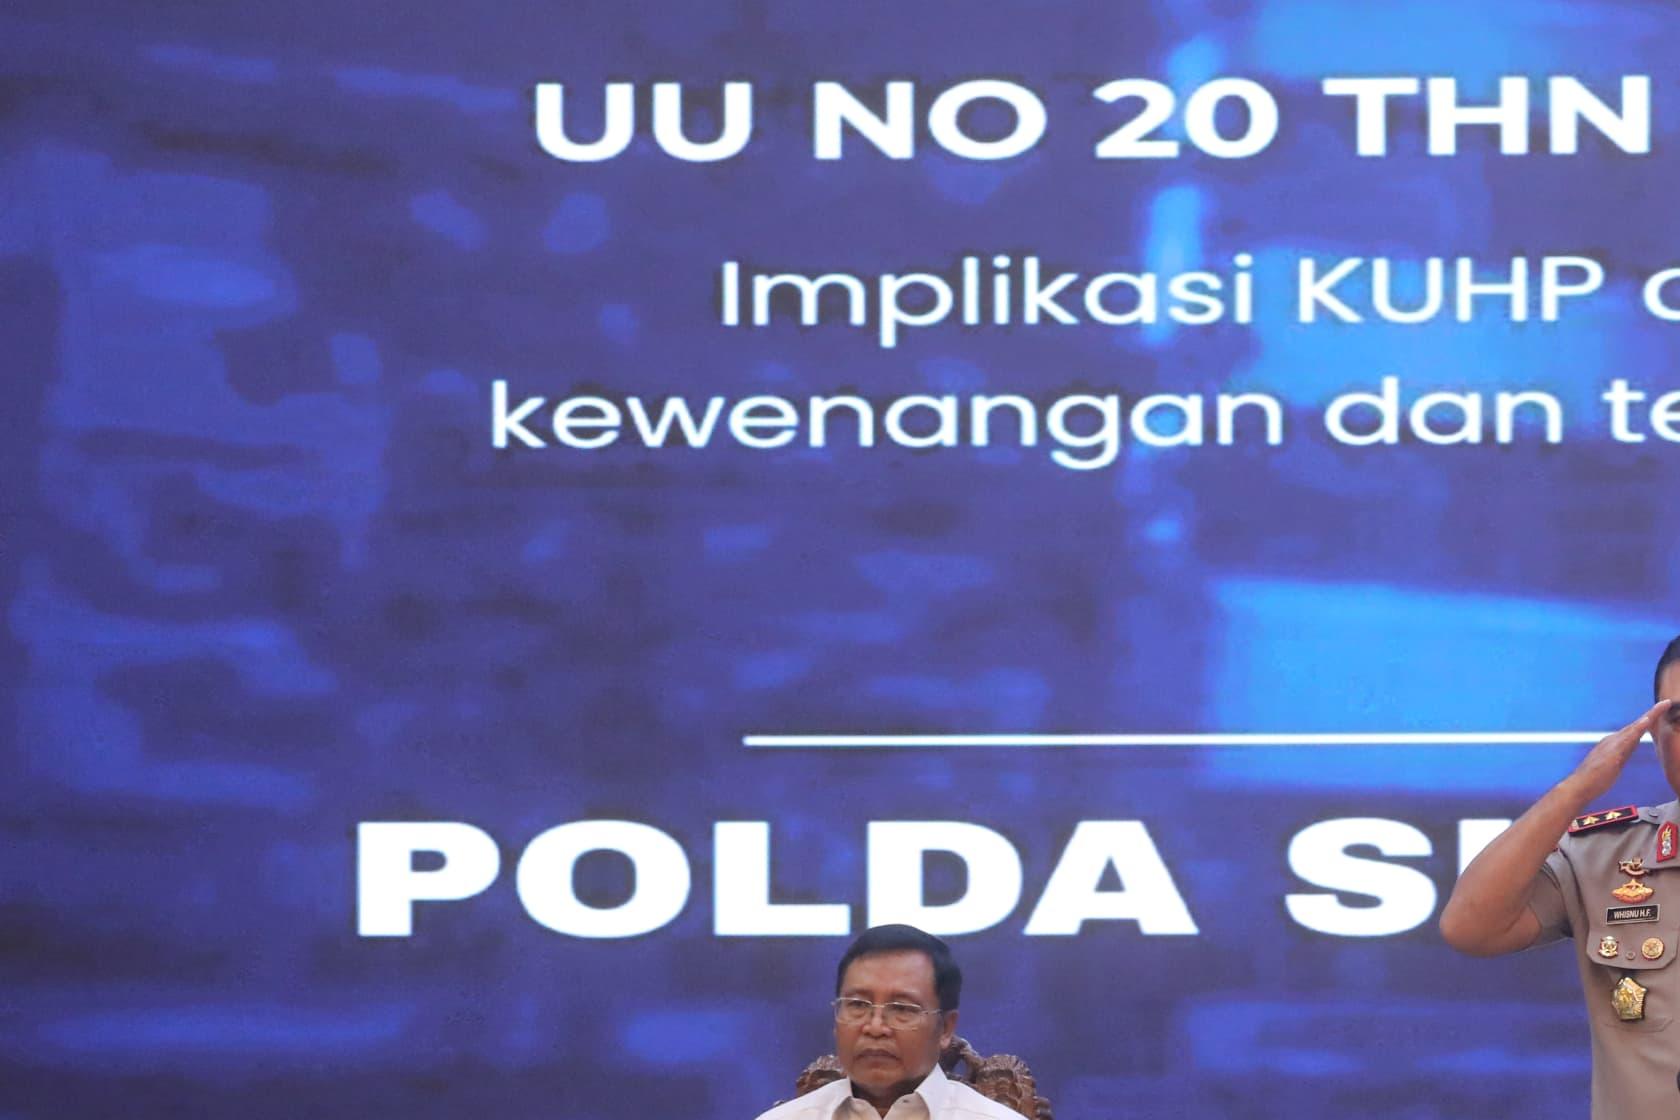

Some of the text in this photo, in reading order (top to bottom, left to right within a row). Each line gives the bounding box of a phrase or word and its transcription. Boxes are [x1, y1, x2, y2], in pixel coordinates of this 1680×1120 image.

[537, 82, 751, 161] UU
[814, 80, 1047, 160] NO
[1095, 78, 1278, 158] 20
[1323, 76, 1650, 156] THN
[723, 255, 1252, 348] Implikasi
[1298, 256, 1603, 323] KUHP
[493, 381, 1281, 470] kewenangan
[1325, 376, 1562, 445] dan
[357, 820, 1199, 938] POLDA
[1613, 909, 1639, 919] WHISNU
